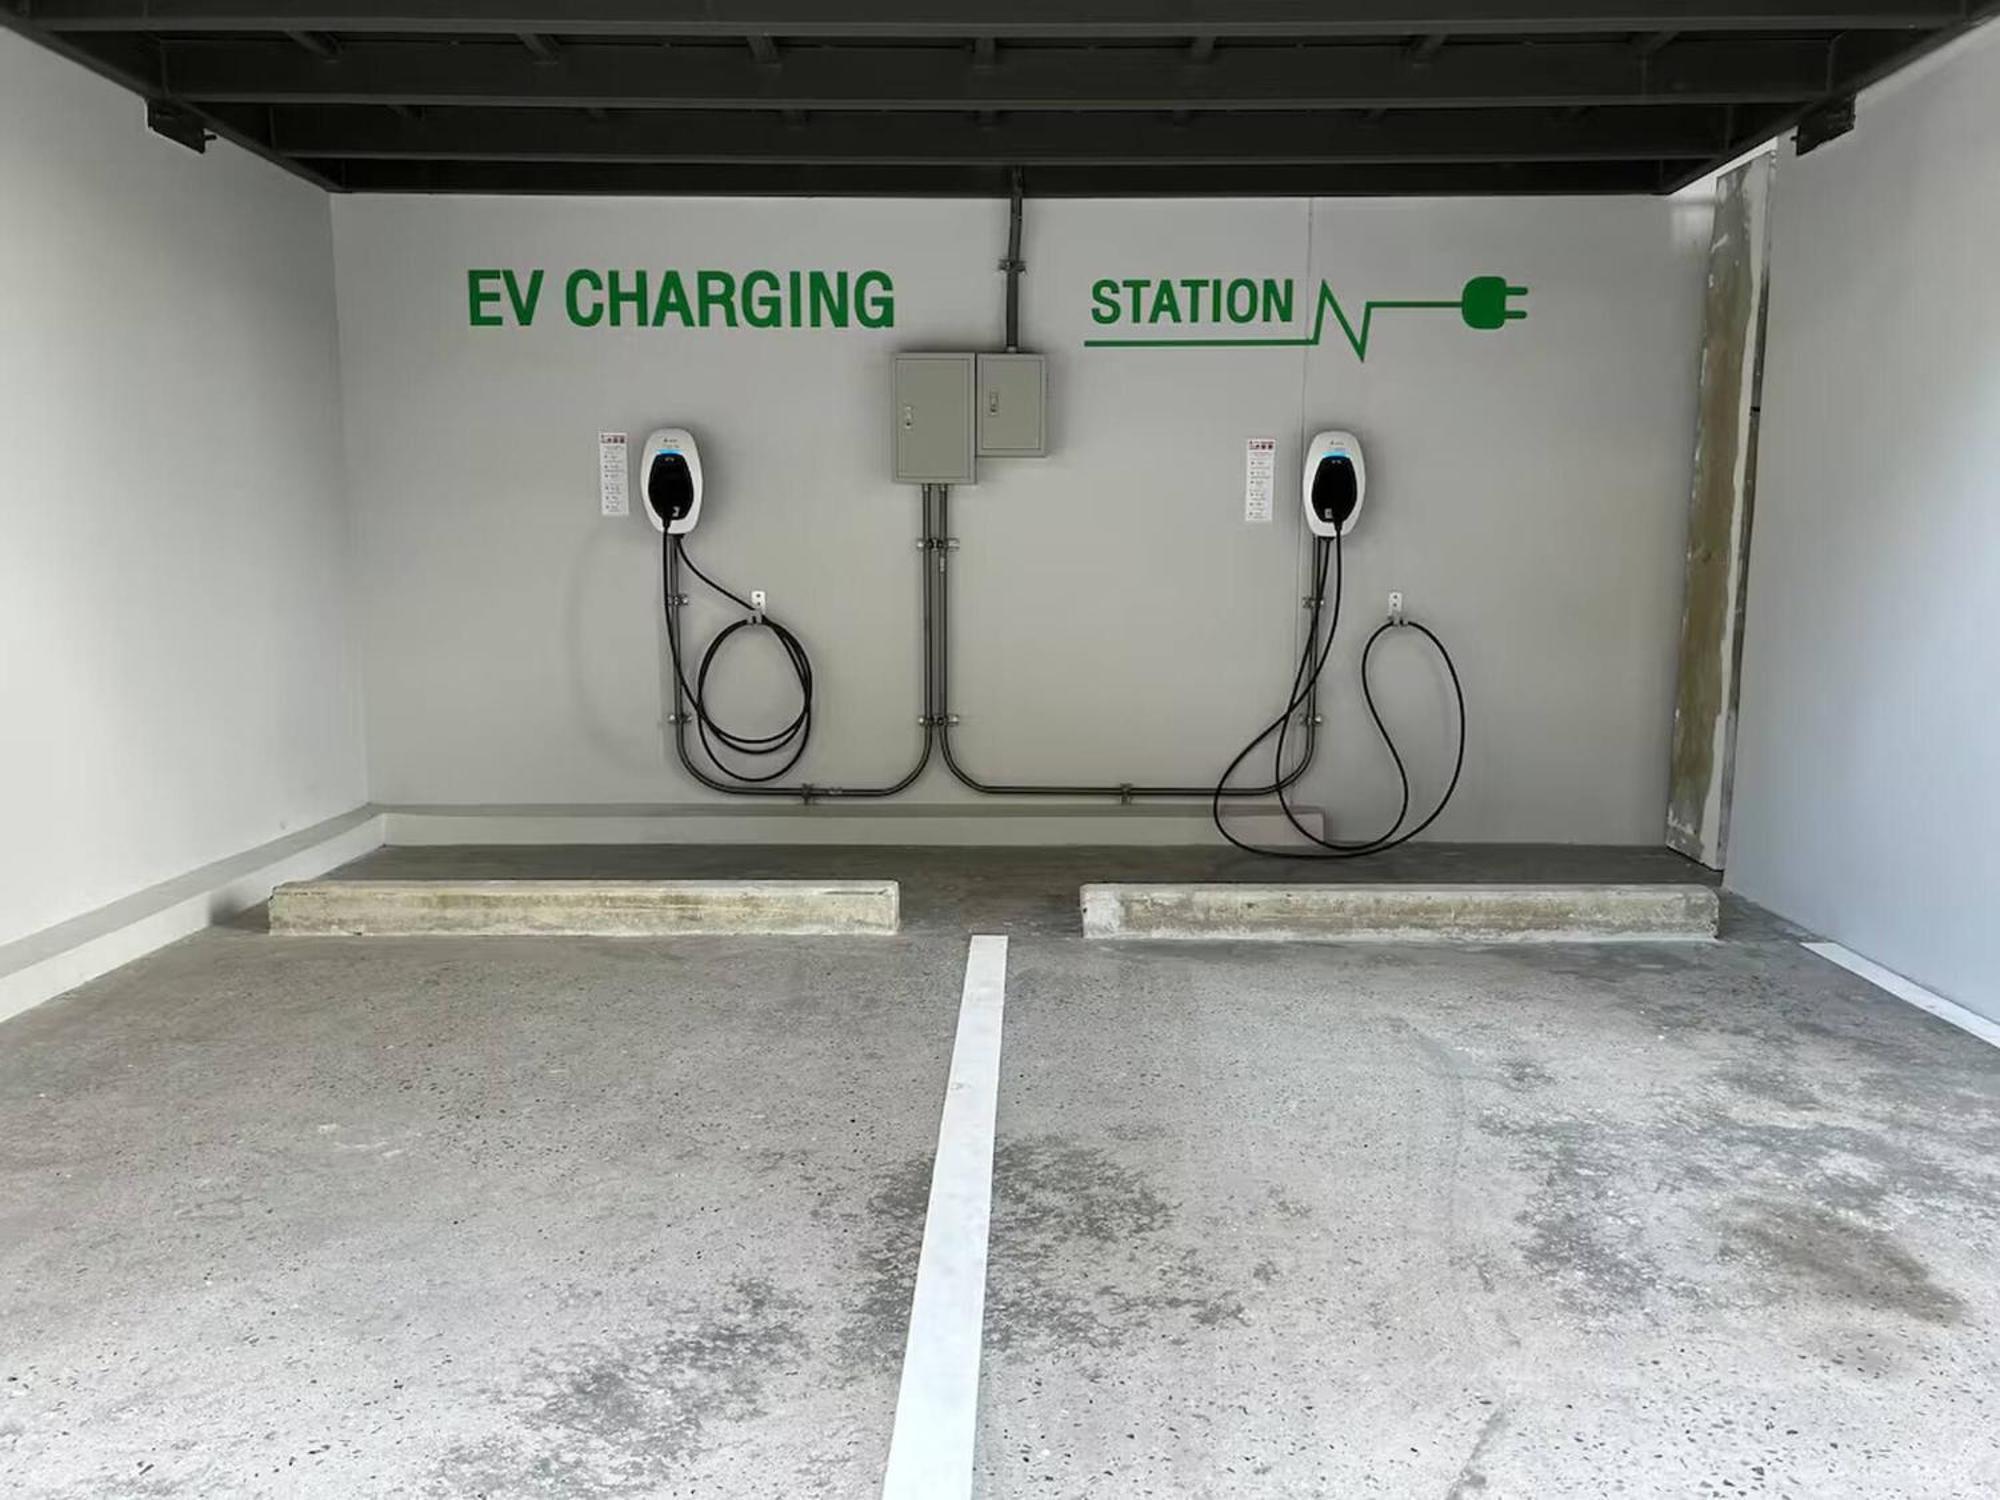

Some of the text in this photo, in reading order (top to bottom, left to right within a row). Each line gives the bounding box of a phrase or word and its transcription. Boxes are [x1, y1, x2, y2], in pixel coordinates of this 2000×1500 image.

[469, 270, 1292, 328] EV CHARGING STATION
